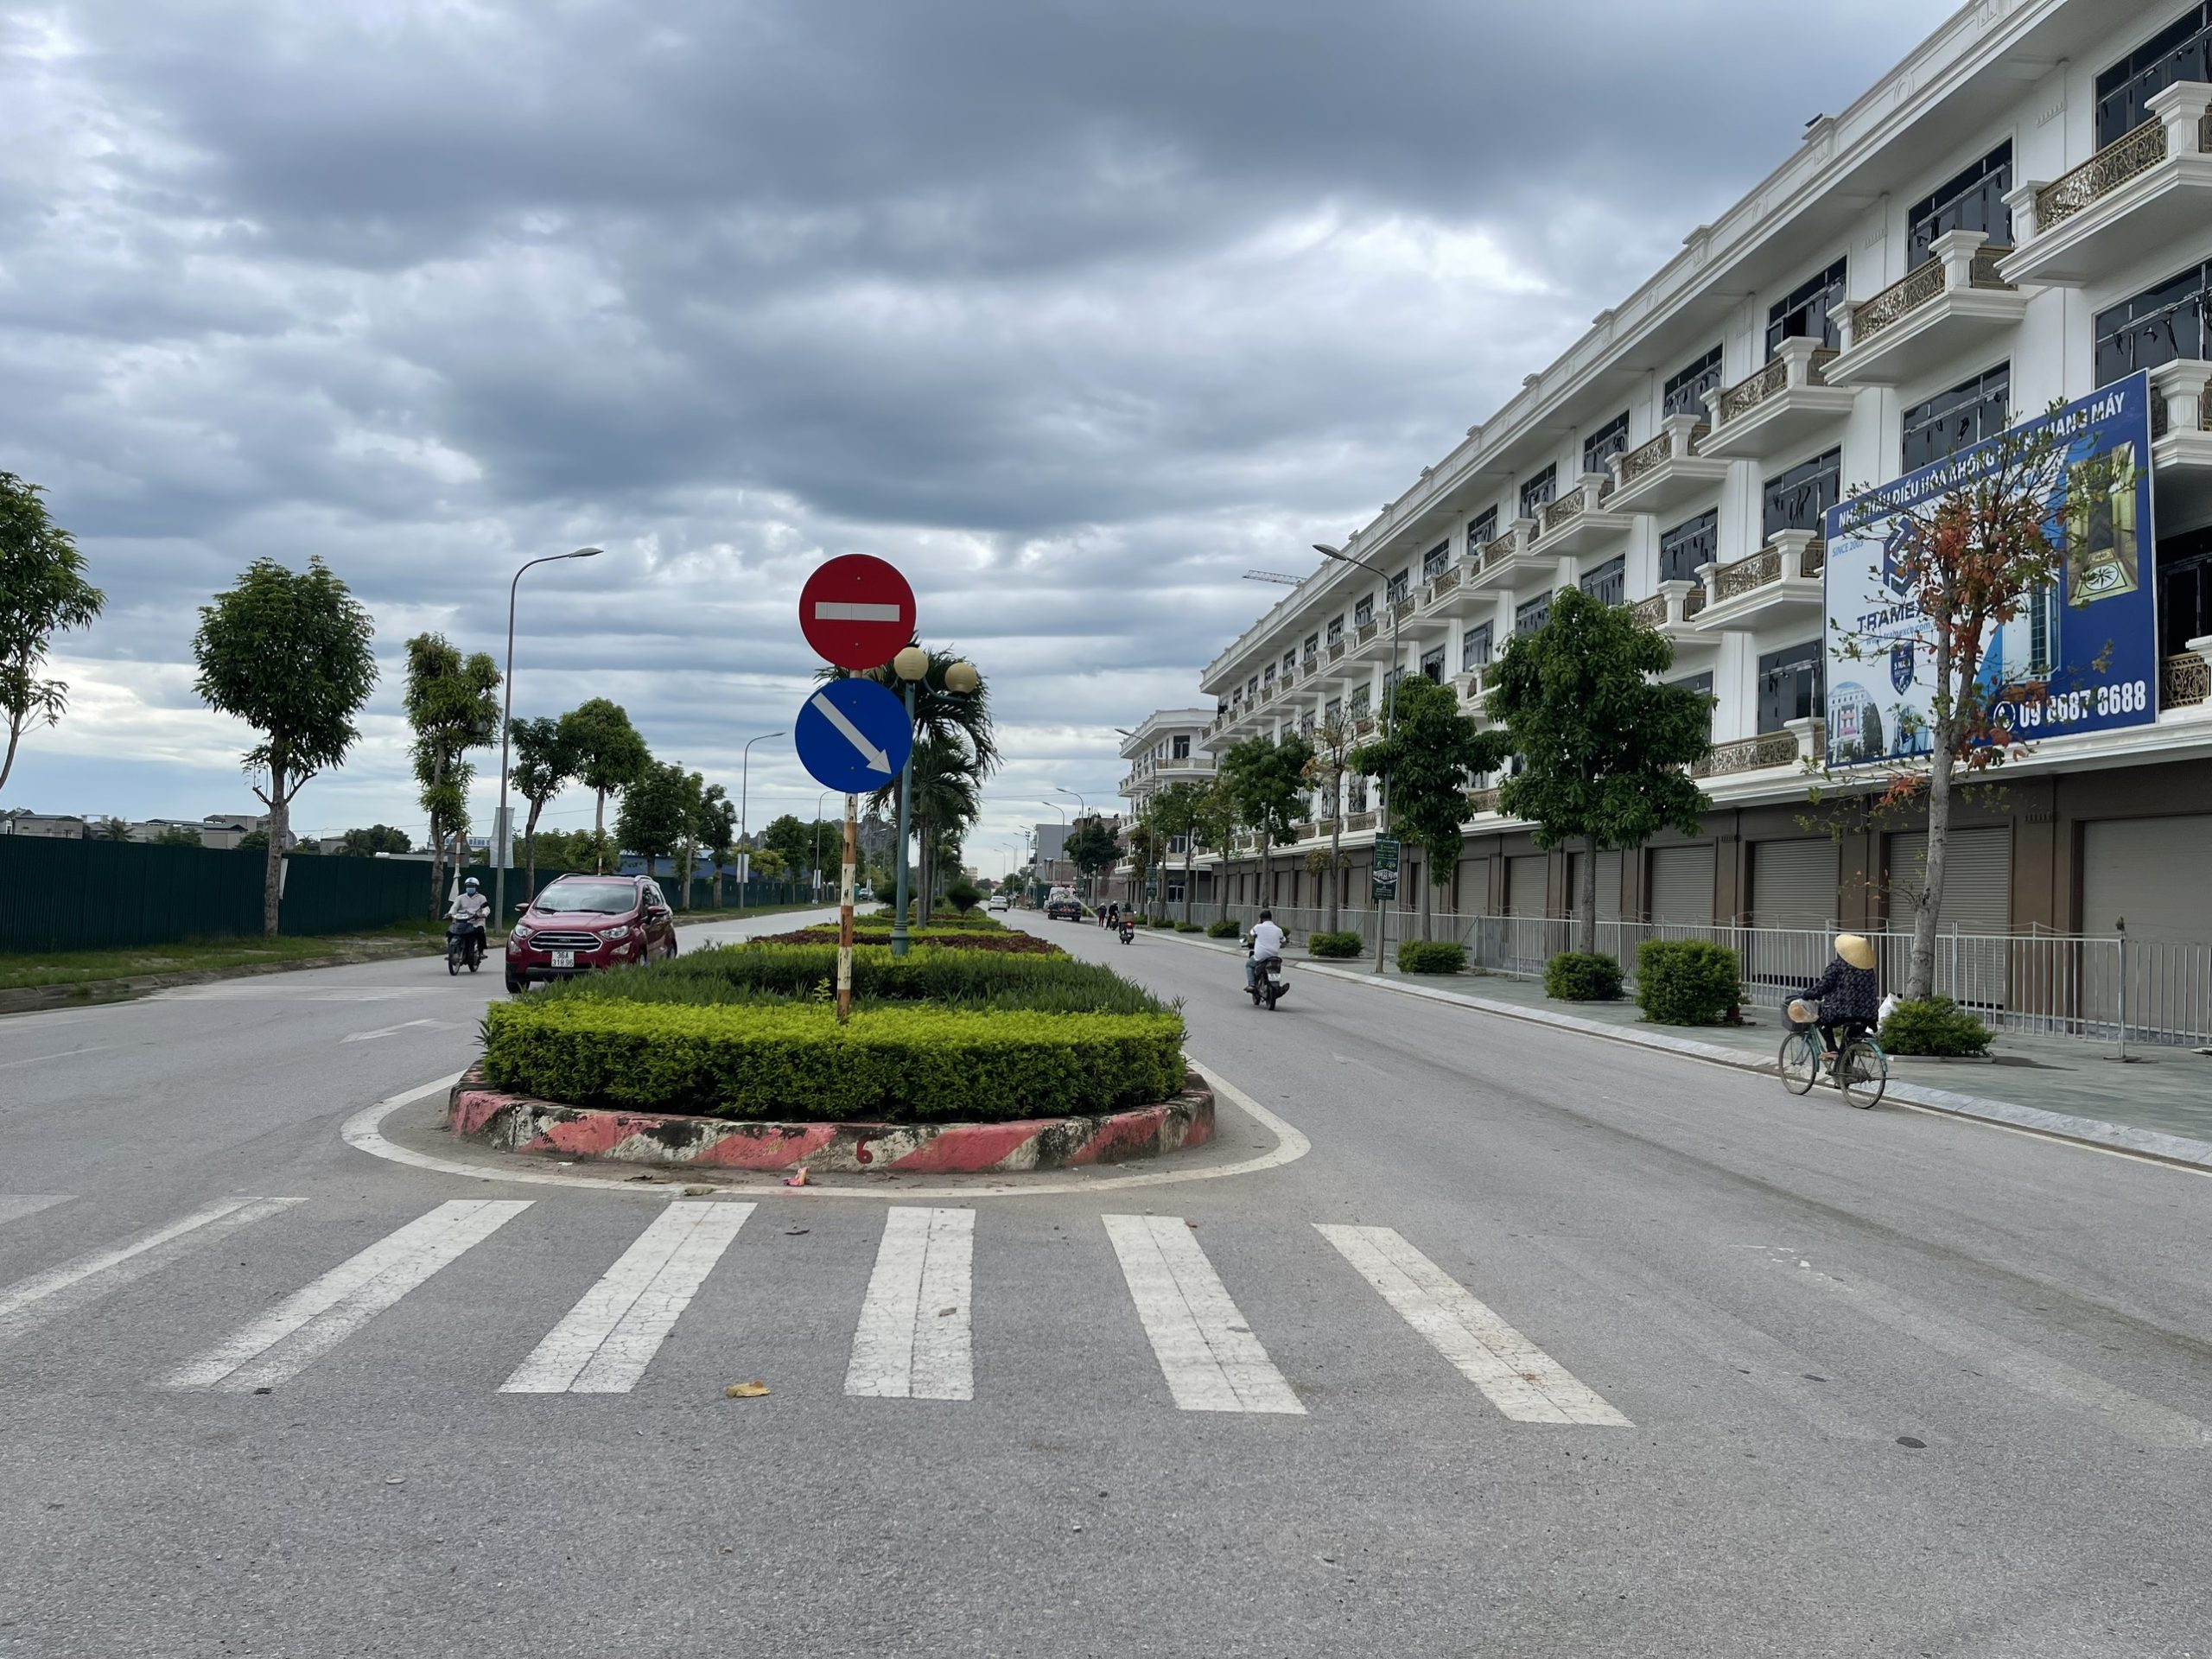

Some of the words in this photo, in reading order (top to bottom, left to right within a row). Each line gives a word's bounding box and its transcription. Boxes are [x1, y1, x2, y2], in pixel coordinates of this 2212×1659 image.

[2091, 391, 2126, 424] MÁY
[1832, 542, 1848, 557] SINCE
[856, 1134, 877, 1165] 6
